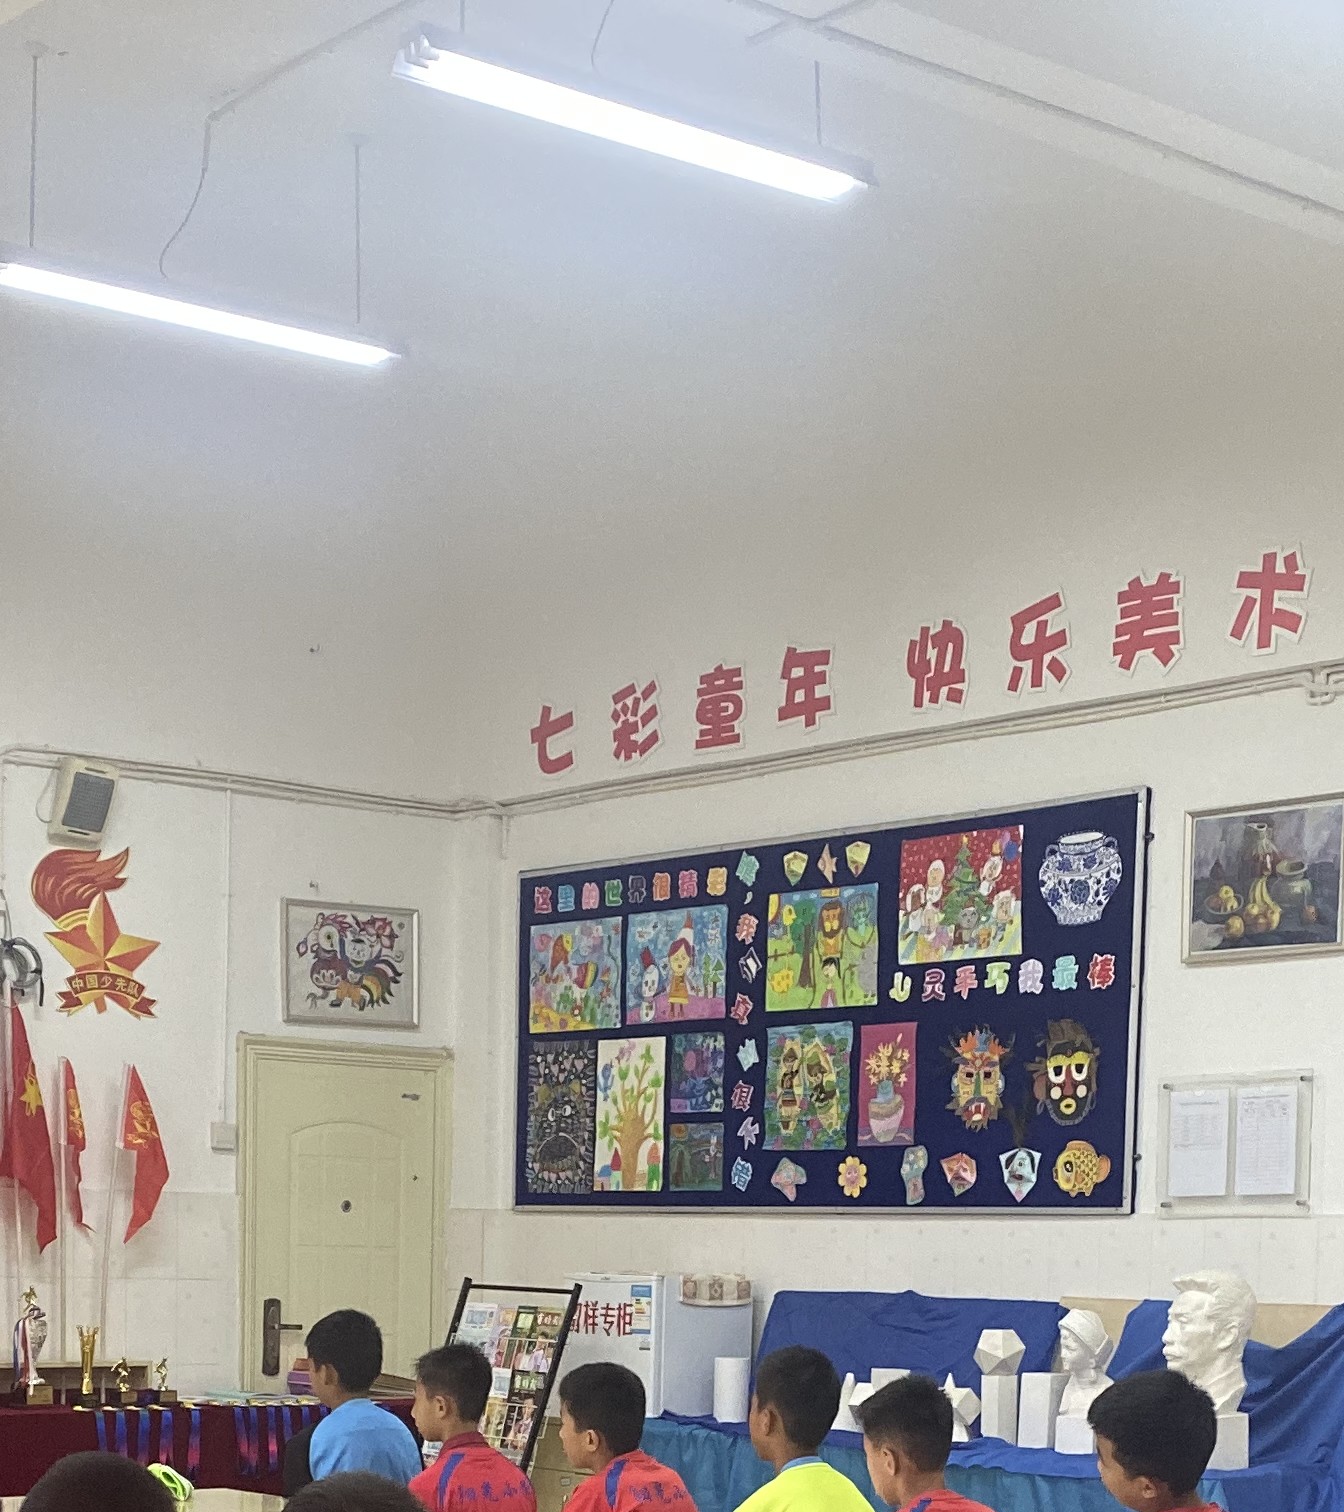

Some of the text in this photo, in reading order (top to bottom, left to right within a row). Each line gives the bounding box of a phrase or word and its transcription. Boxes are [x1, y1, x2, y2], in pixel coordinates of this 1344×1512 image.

[530, 548, 1309, 776] 七彩童年 快乐美术
[71, 974, 140, 998] 中国少先队
[888, 952, 1116, 1003] 心灵手巧我最棒
